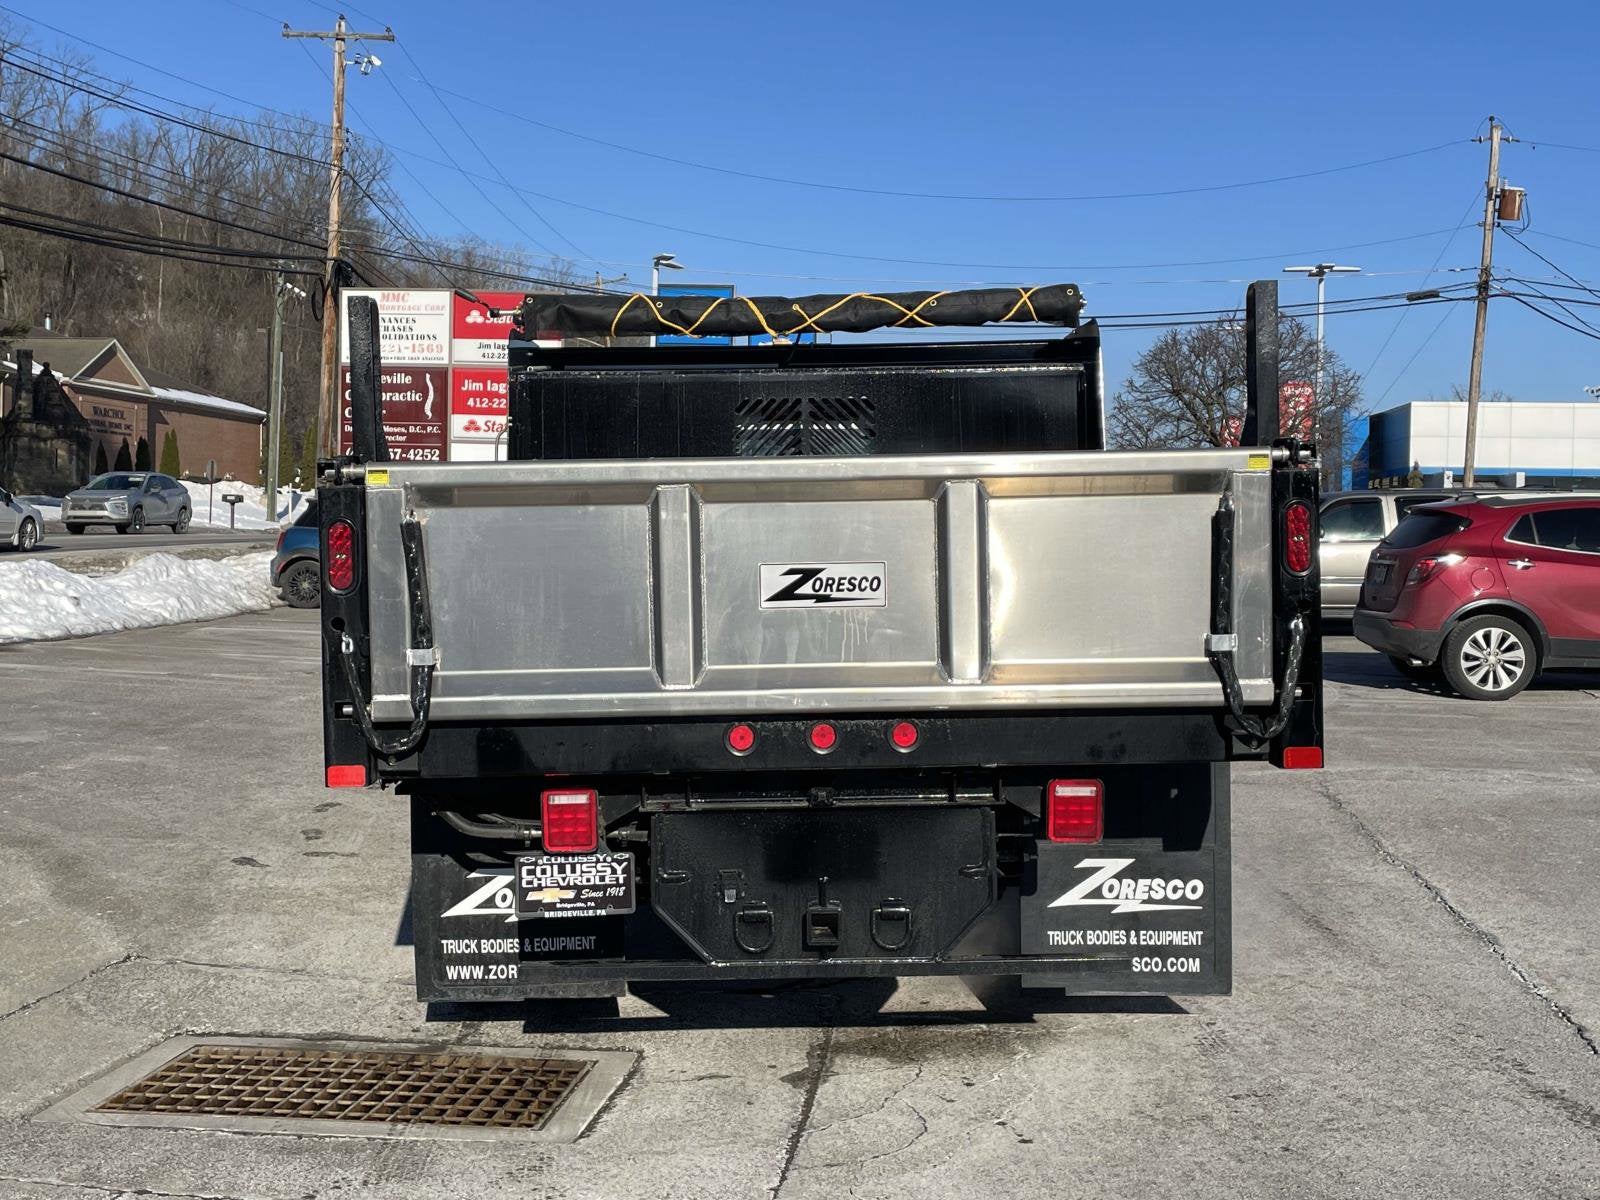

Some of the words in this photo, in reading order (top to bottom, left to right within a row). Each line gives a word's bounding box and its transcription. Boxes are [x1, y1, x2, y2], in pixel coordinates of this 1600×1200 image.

[380, 292, 410, 303] MMC
[477, 341, 491, 350] Jim
[461, 379, 483, 391] Jim
[763, 567, 882, 604] ZORESCO
[521, 861, 628, 879] COLUSSY
[521, 874, 628, 888] CHEVROLET
[1047, 858, 1204, 914] ZORESCO
[580, 888, 604, 899] Since
[605, 886, 626, 897] 1918
[441, 939, 478, 954] TRUCK
[481, 938, 520, 954] BODIES
[524, 937, 533, 952] &
[534, 936, 597, 952] EQUIPMENT
[1047, 930, 1085, 945] TRUCK
[1087, 930, 1127, 945] BODIES
[1129, 930, 1138, 945] &
[1140, 930, 1204, 946] EQUIPMENT
[446, 964, 520, 980] WWW.ZOR
[1132, 957, 1201, 973] SCO.COM
